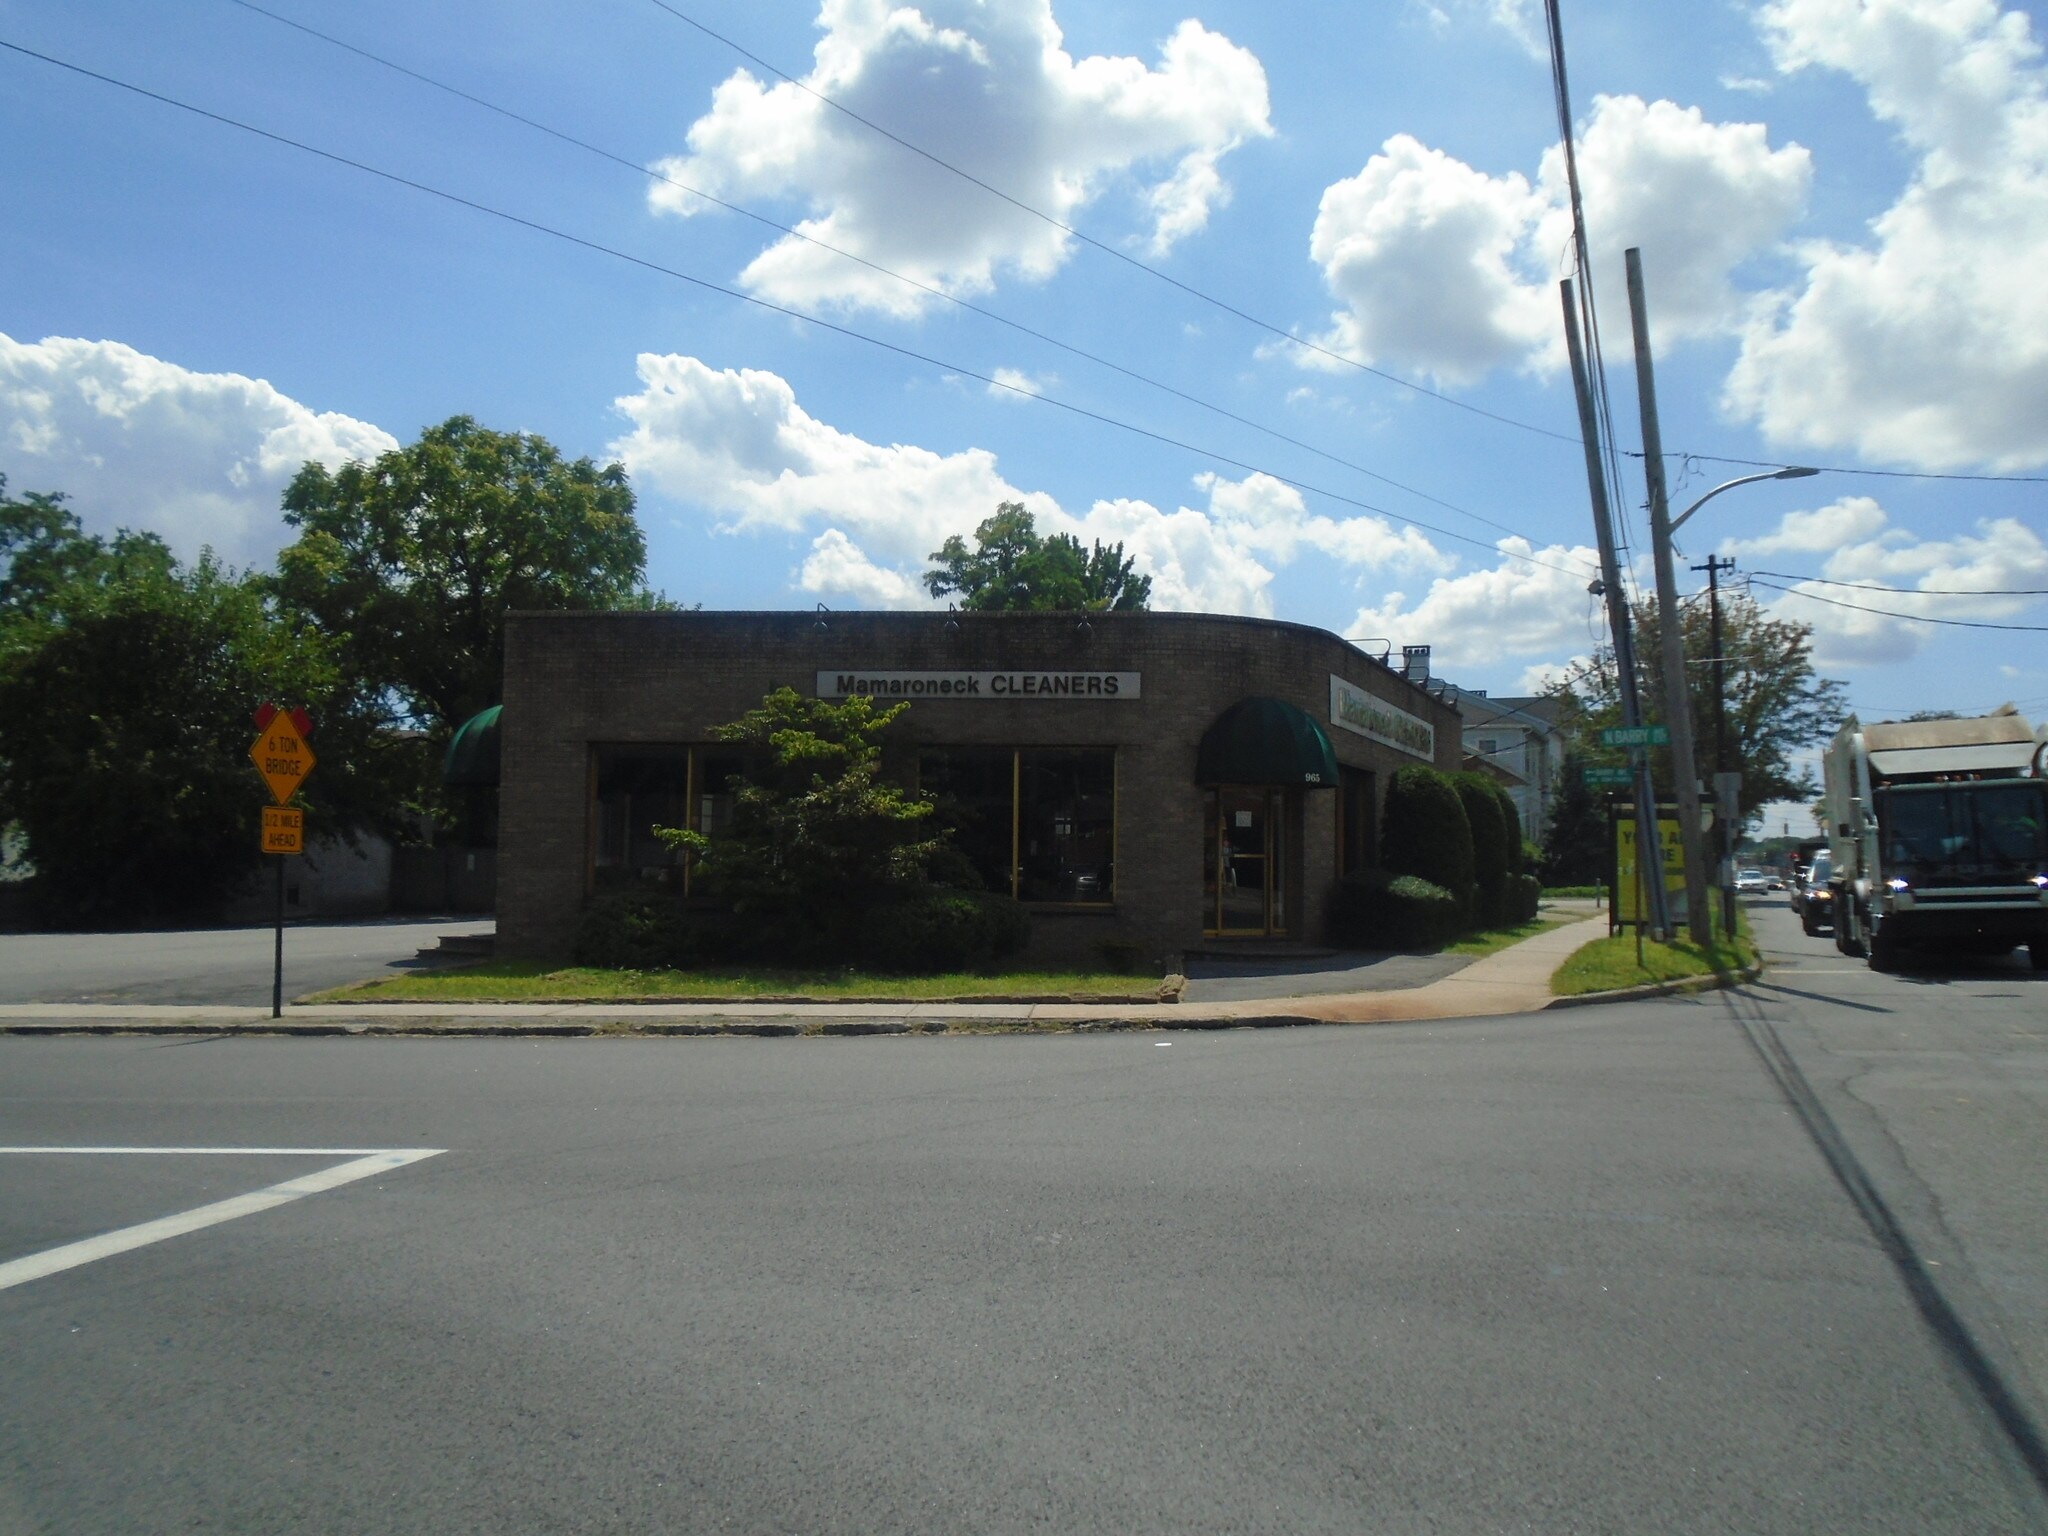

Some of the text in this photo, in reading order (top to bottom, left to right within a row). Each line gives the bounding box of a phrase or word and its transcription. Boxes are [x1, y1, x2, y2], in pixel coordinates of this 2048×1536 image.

[836, 674, 1120, 695] Mamaroneck CLEANERS
[1615, 728, 1649, 744] BARRY
[268, 736, 298, 753] 6 TON
[265, 757, 302, 776] BRIDGE
[1305, 772, 1320, 782] 965
[280, 815, 300, 829] MILE
[268, 832, 296, 847] AHEAD
